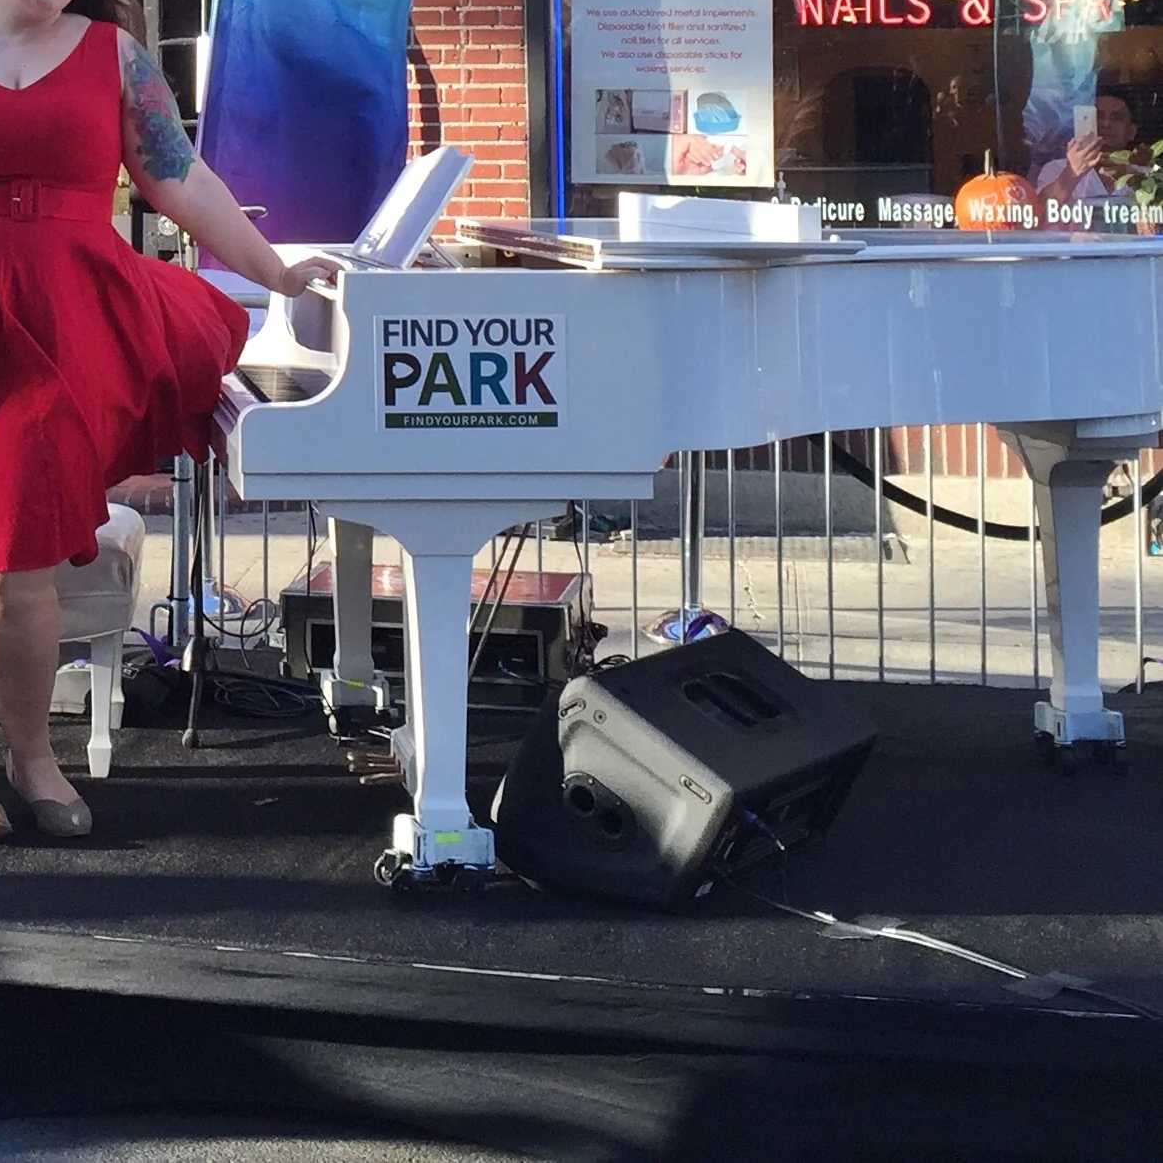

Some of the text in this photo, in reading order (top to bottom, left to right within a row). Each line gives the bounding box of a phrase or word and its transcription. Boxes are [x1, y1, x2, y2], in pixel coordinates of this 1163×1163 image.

[586, 9, 600, 17] We
[674, 9, 701, 17] metal
[598, 23, 645, 32] Disposable
[686, 23, 705, 31] and
[655, 51, 703, 61] disposable
[730, 51, 742, 59] for
[878, 197, 959, 228] Massage,
[969, 198, 1039, 229] Waxing,
[1047, 198, 1094, 230] Body
[383, 318, 555, 347] FIND YOUR
[384, 351, 558, 406] PARK
[403, 415, 539, 426] FINDYOURPARK.COM
